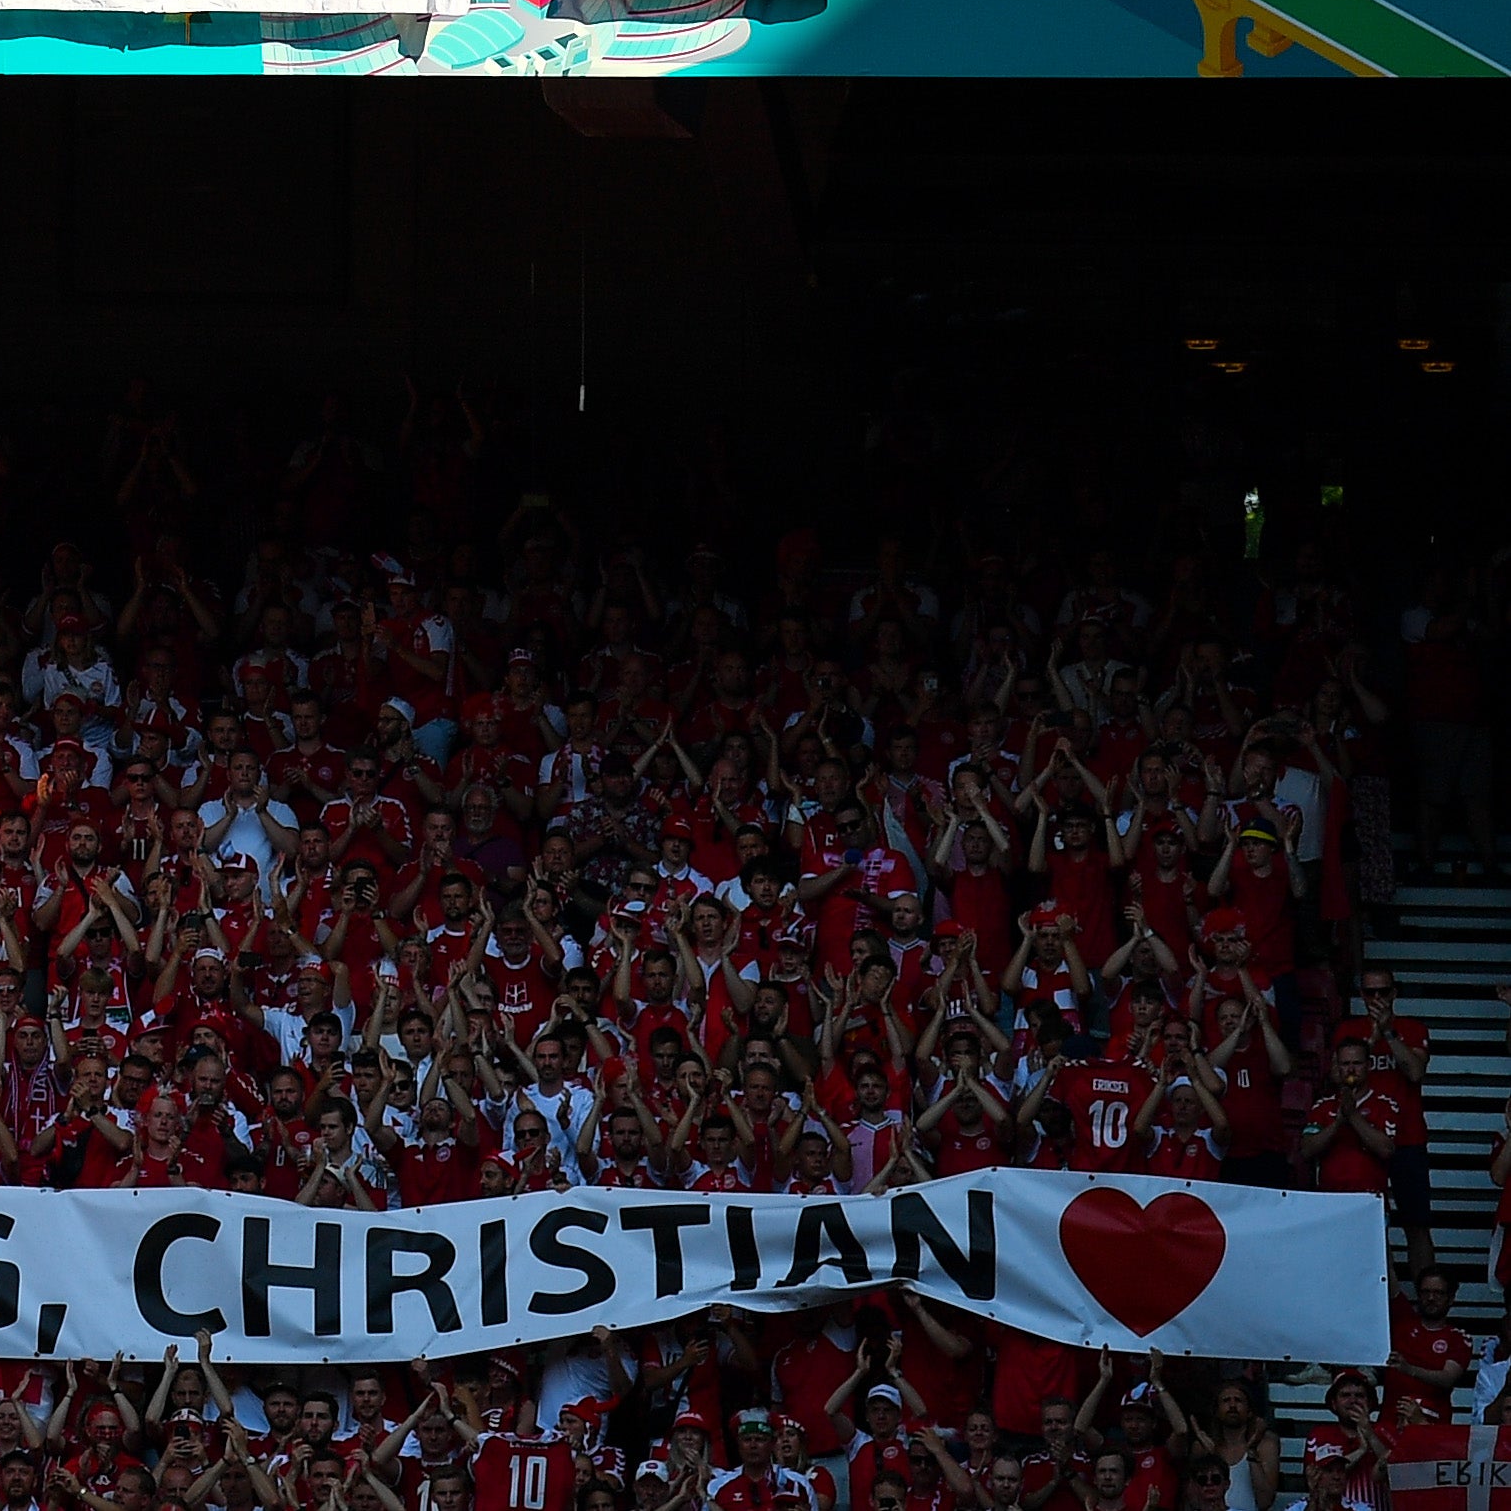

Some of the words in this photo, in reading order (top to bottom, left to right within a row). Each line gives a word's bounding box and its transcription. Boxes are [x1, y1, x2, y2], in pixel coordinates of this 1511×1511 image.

[132, 839, 145, 859] 11
[1092, 1078, 1130, 1094] ERIKSEN
[1088, 1099, 1129, 1149] 10
[134, 1190, 996, 1338] CHRISTIAN
[508, 1455, 548, 1510] 10
